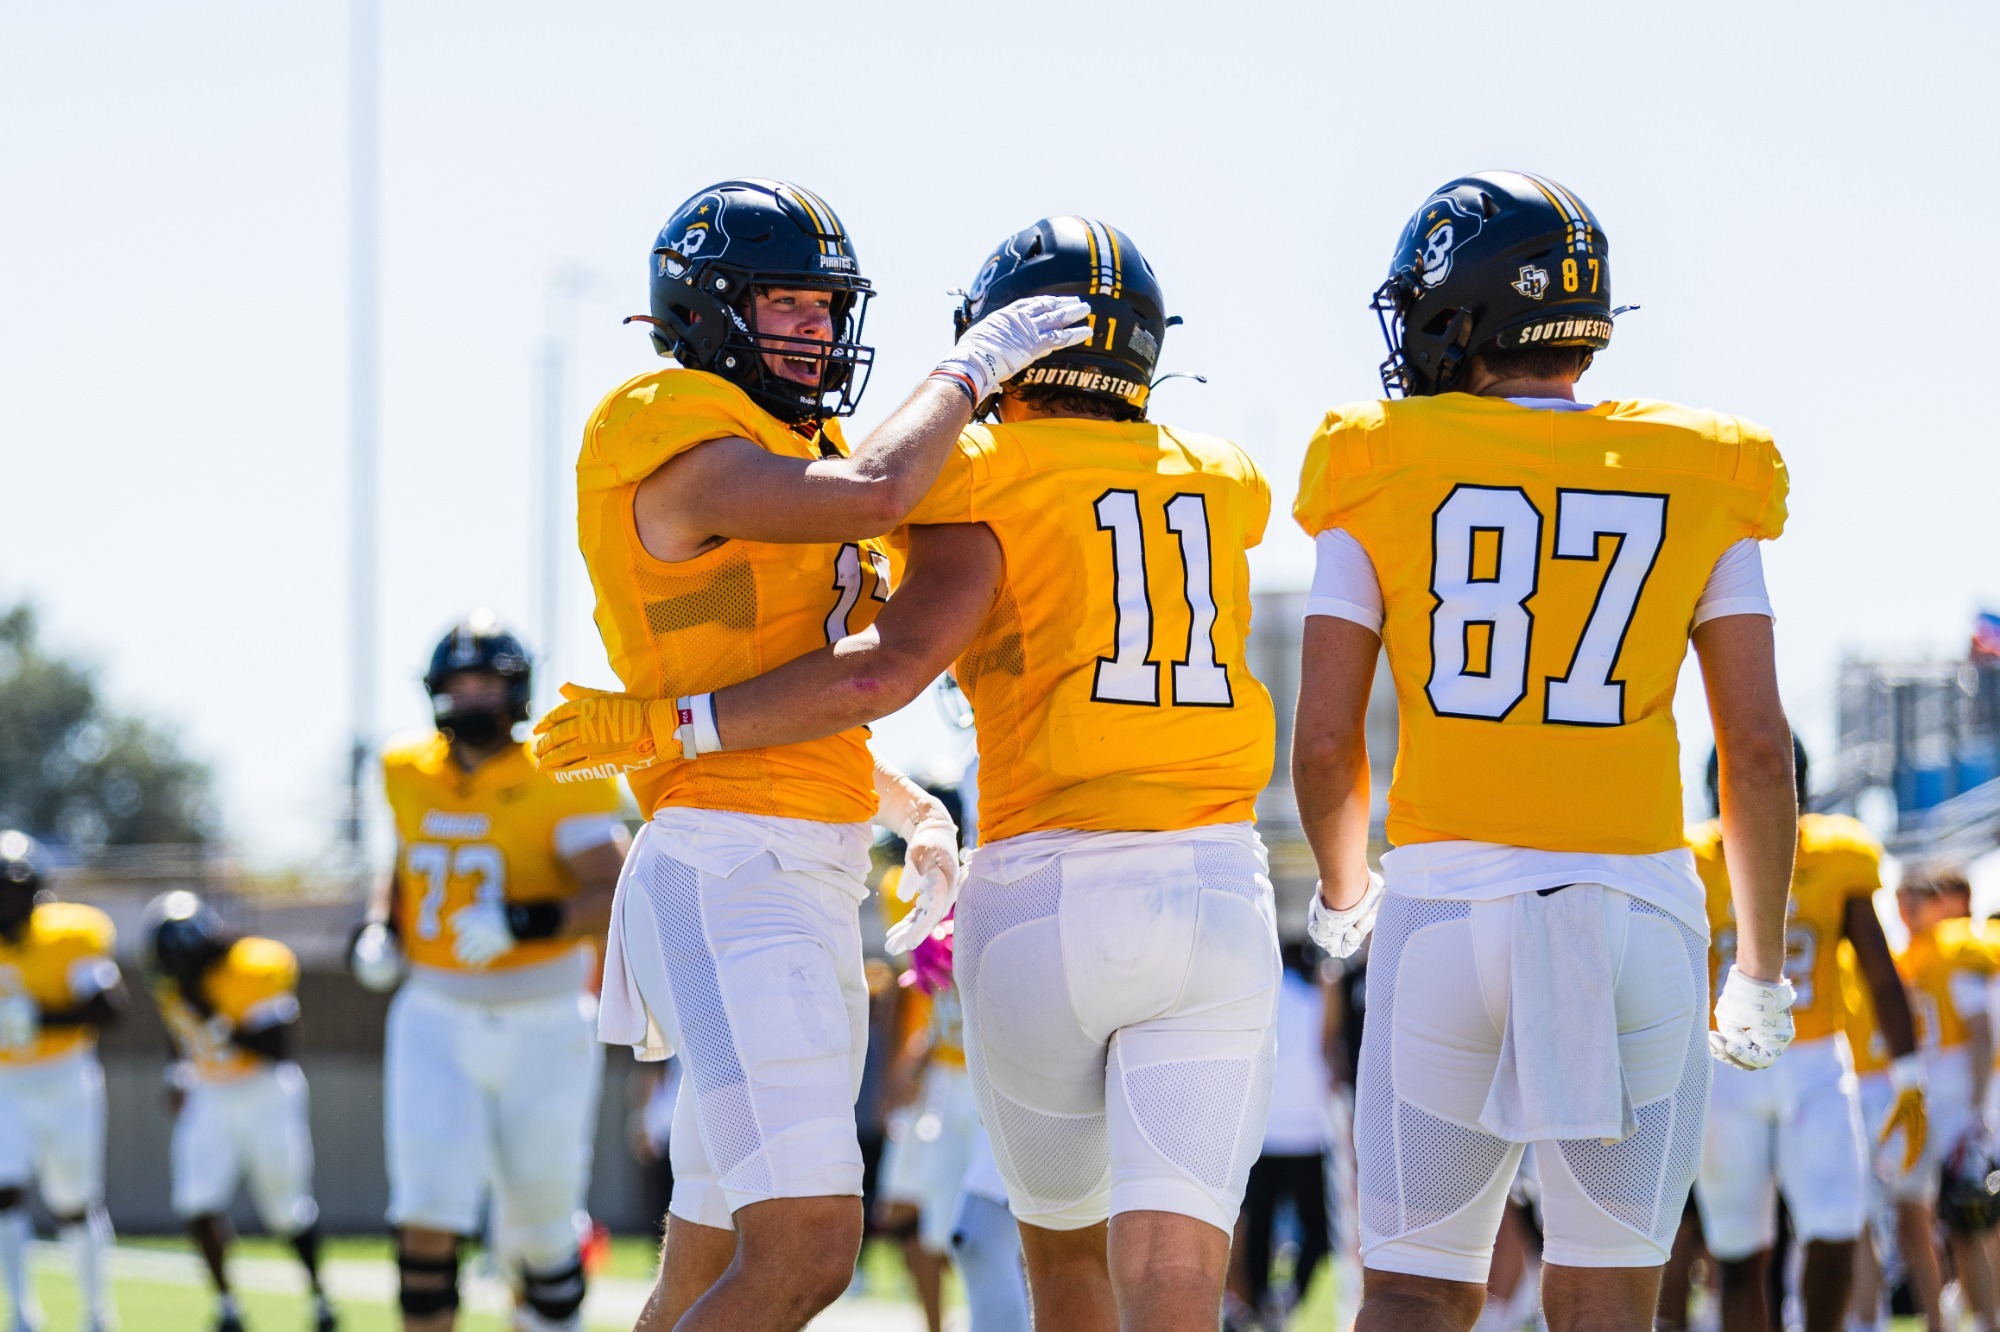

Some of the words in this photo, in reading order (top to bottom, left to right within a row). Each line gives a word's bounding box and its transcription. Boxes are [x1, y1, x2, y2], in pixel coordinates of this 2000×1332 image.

[1561, 258, 1599, 293] 87
[1084, 313, 1118, 351] 11
[1023, 367, 1141, 400] SOUTHWESTERN
[1090, 488, 1235, 708] 11
[1424, 483, 1670, 727] 87
